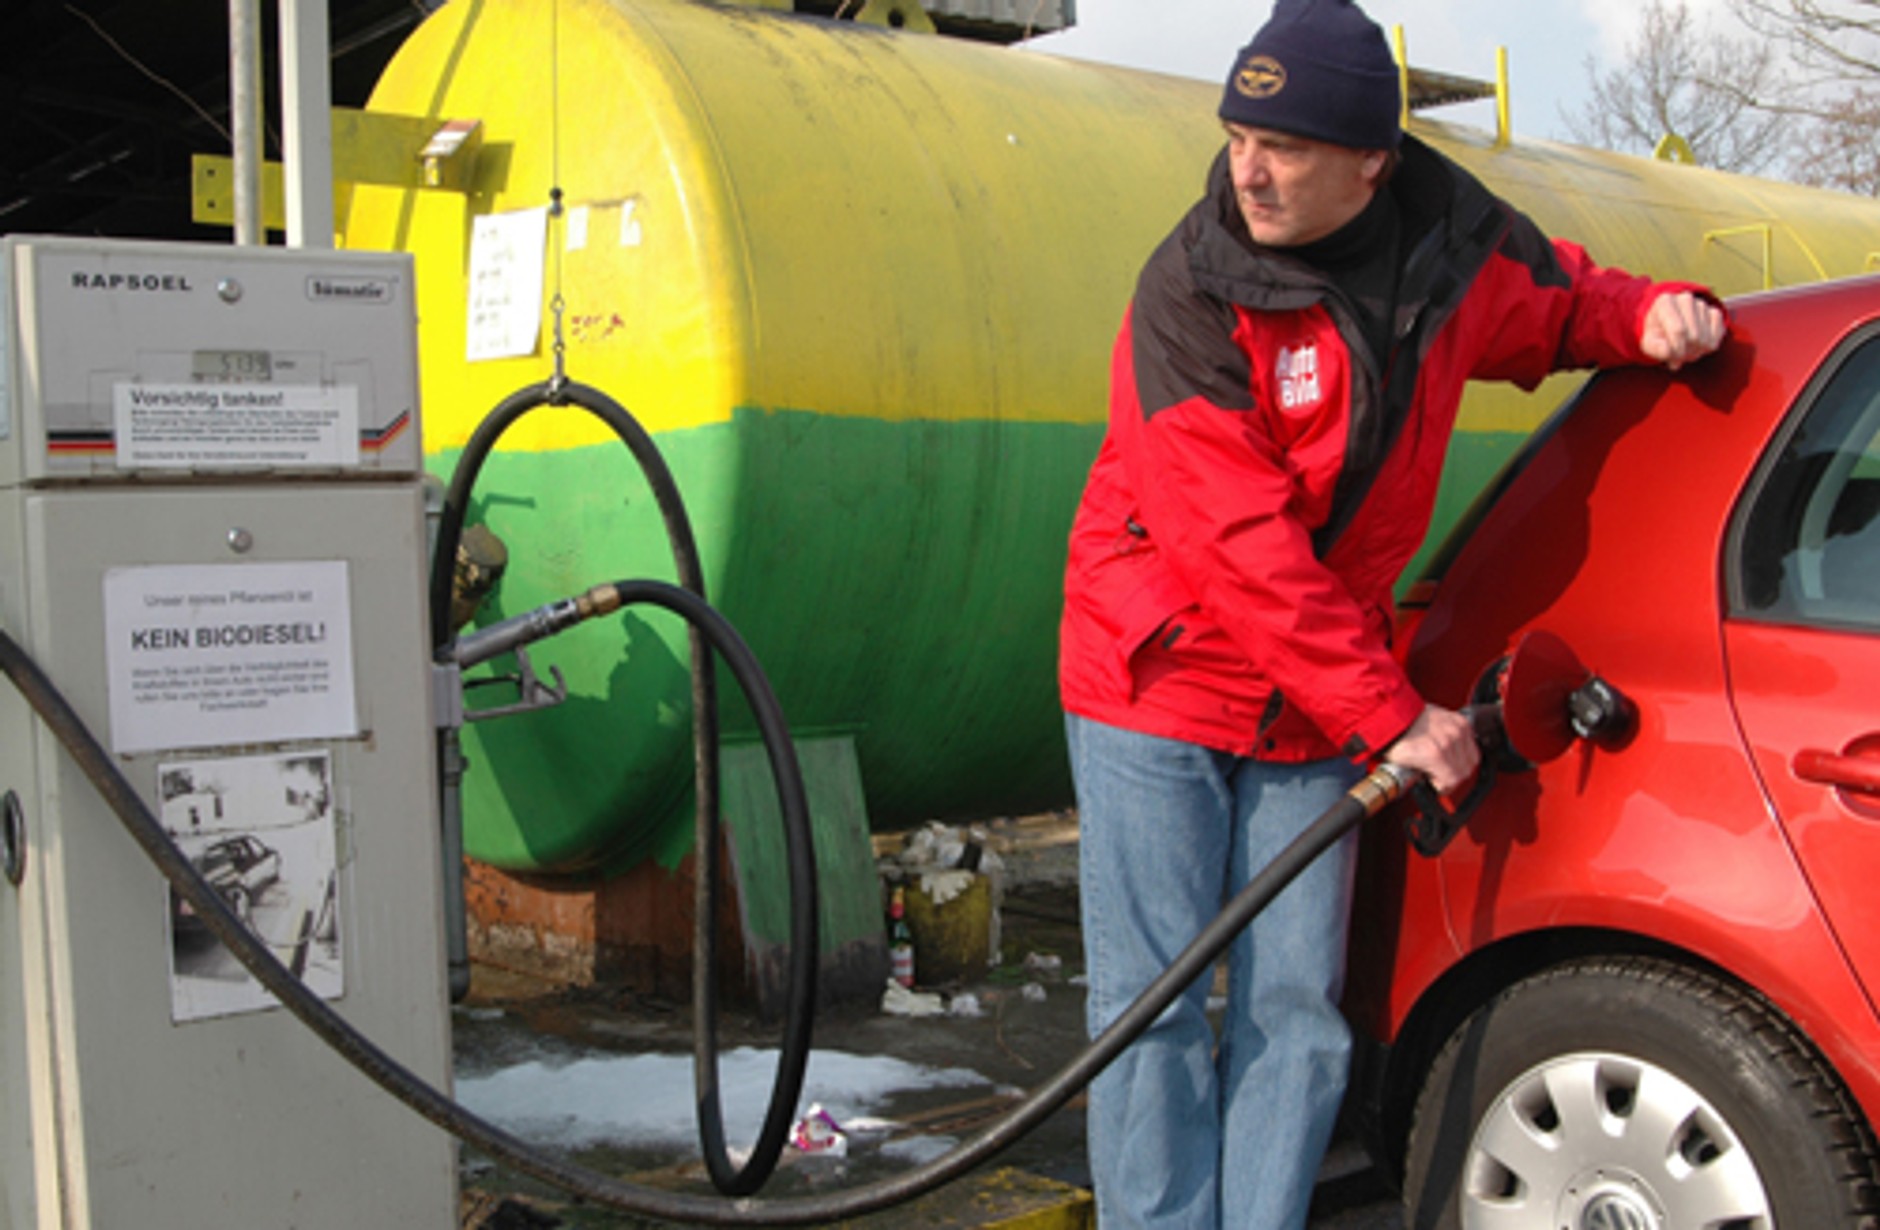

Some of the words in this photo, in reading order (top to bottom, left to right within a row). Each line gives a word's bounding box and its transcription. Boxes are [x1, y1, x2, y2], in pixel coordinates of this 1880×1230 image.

[72, 273, 192, 291] RAPSOEL
[130, 389, 219, 409] Vorsichtig
[222, 390, 283, 407] tanken!
[131, 628, 189, 650] KEIN
[196, 622, 325, 648] BIODIESEL!
